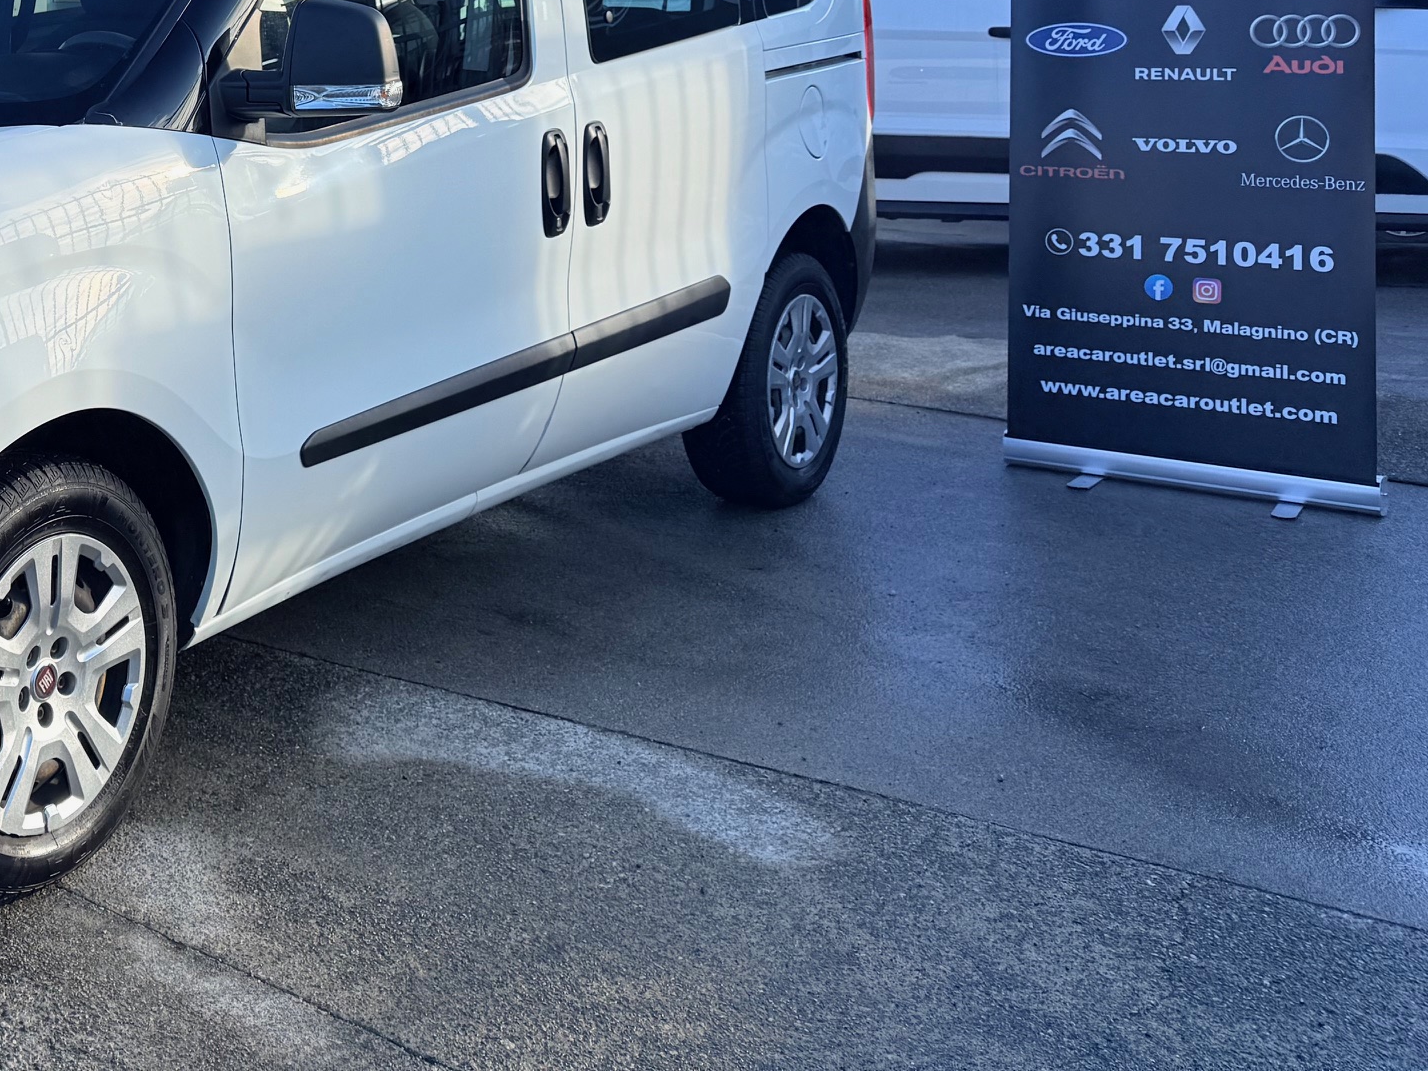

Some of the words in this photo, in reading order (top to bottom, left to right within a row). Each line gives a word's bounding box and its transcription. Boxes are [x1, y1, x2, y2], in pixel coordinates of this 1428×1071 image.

[1045, 27, 1106, 52] Ford
[1134, 67, 1237, 81] RENAULT
[1132, 137, 1238, 154] VOLVO
[1240, 172, 1366, 192] Mercedes-Benz
[1077, 232, 1143, 260] 331
[1159, 237, 1335, 273] 7510416
[1022, 304, 1052, 320] Via
[1056, 307, 1164, 329] Giuseppina
[1167, 317, 1198, 334] 33,
[1203, 320, 1309, 344] Malagnino
[1314, 328, 1359, 348] (CR)
[1033, 343, 1347, 386] areacaroutlet.srl@gmail.com
[1040, 381, 1338, 425] www.areacaroutlet.com
[38, 668, 54, 693] FIAT
